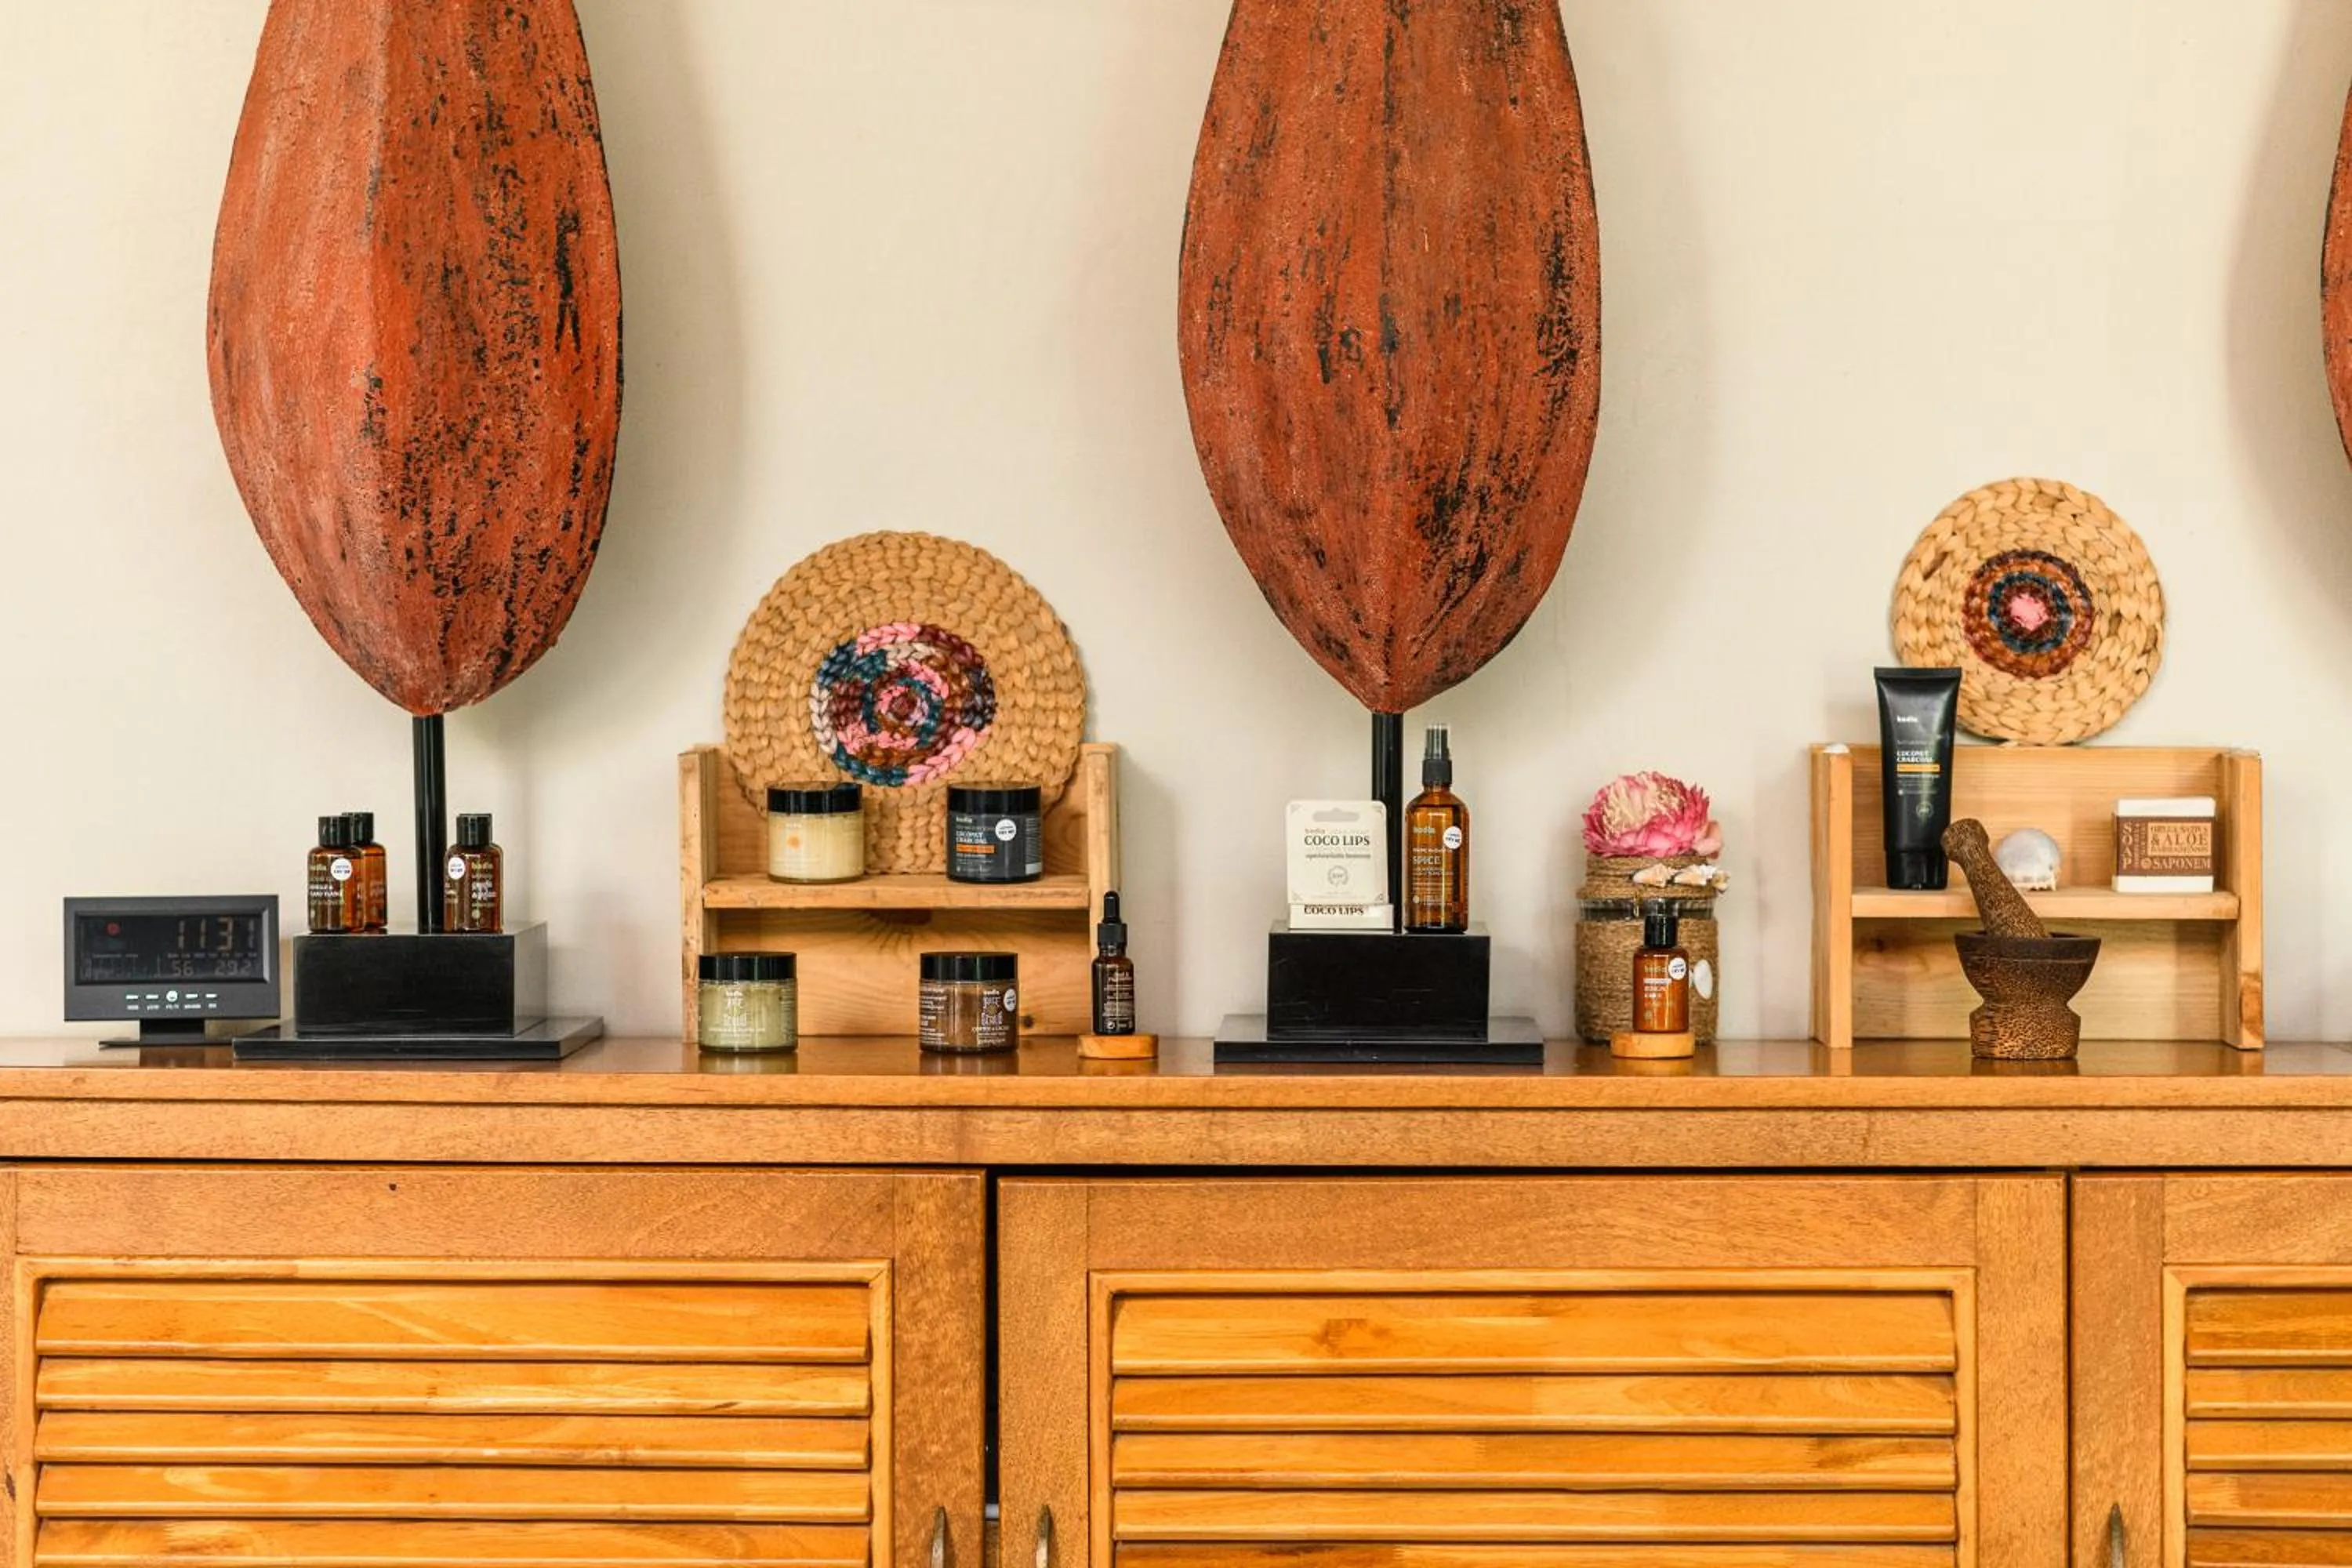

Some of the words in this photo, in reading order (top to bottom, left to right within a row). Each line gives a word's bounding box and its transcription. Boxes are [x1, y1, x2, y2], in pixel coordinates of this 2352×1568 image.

[1304, 835, 1340, 846] COCO
[1343, 835, 1370, 846] LIPS
[2151, 833, 2160, 846] &
[2161, 833, 2208, 846] ALOE
[2122, 822, 2132, 870] SOAP
[2153, 857, 2211, 869] SAPONEM
[1304, 906, 1337, 916] COCO
[1338, 906, 1365, 916] LIPS
